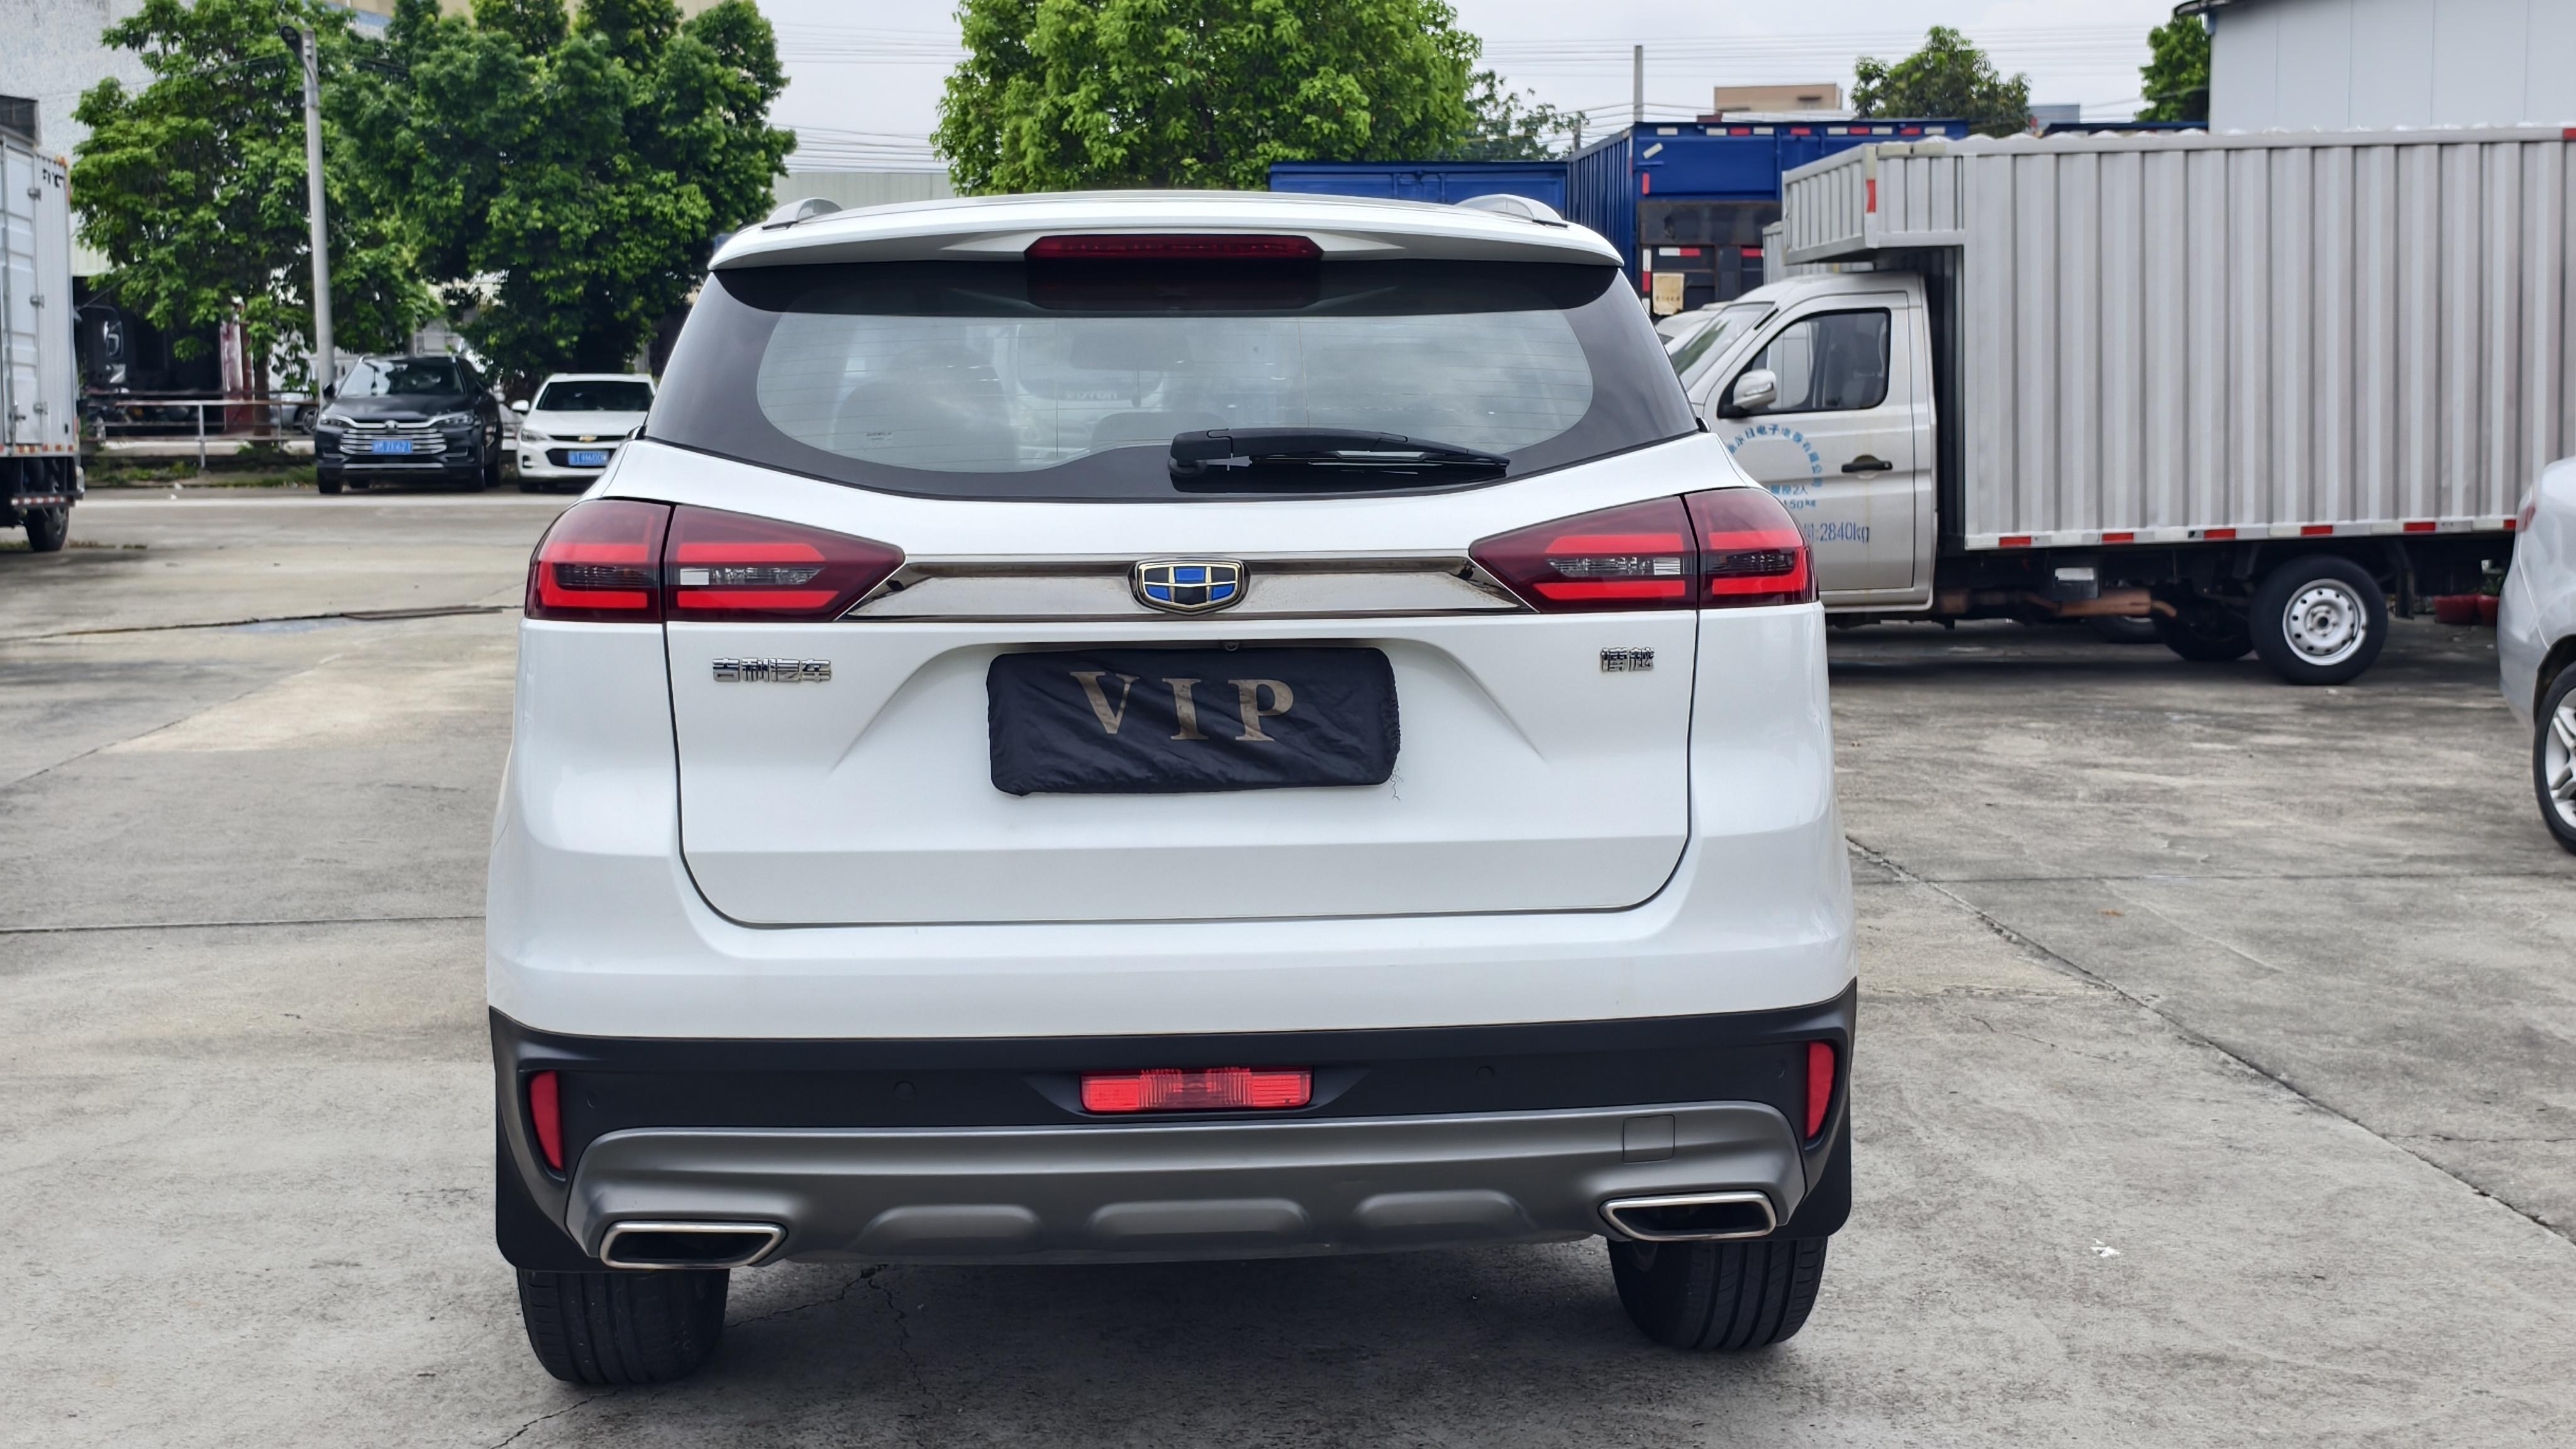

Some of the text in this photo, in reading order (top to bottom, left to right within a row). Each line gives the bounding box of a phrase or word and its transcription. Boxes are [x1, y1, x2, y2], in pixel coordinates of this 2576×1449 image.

[712, 657, 831, 682] 吉利汽车
[1069, 670, 1294, 741] VIP
